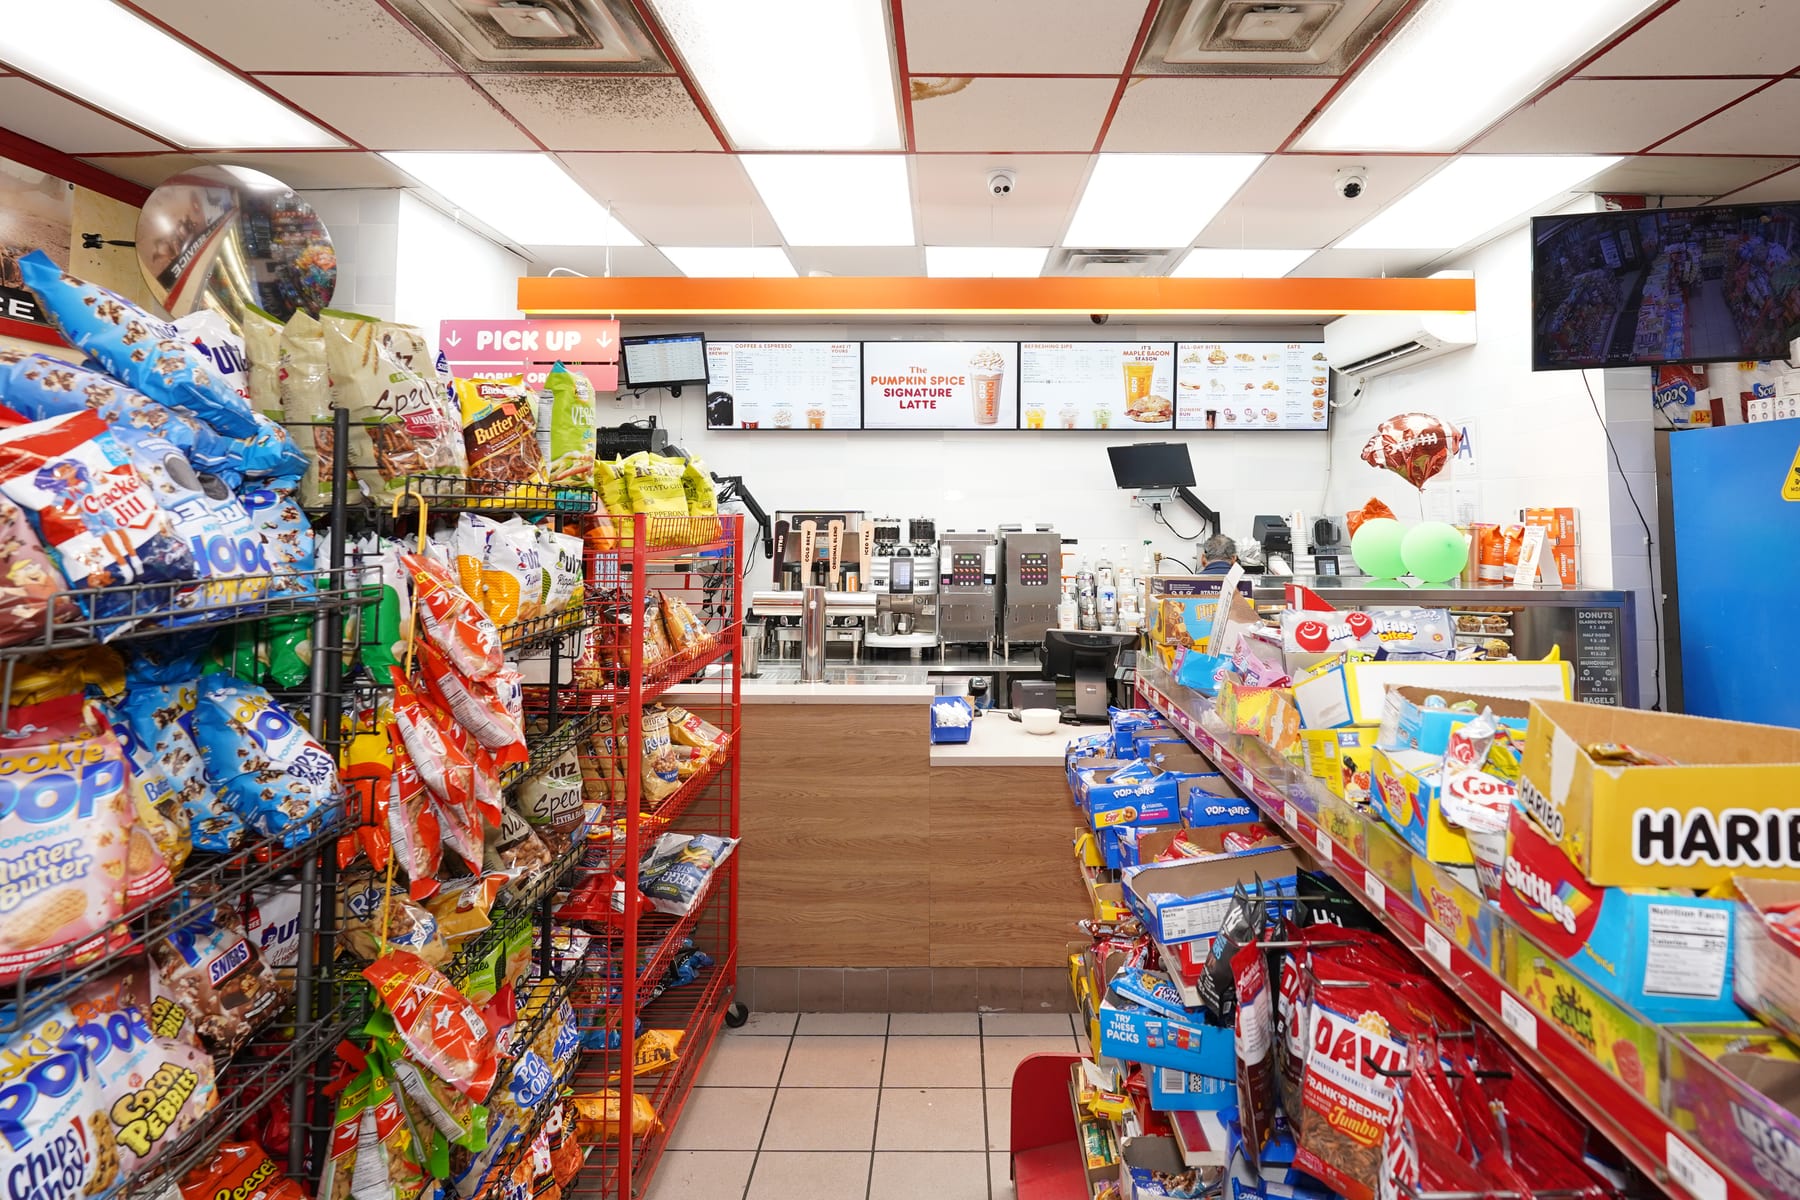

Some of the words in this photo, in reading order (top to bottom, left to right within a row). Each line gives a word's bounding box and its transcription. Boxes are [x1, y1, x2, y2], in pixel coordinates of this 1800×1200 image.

[476, 330, 539, 351] PICK
[545, 331, 581, 351] UP
[526, 371, 549, 384] OR
[909, 366, 928, 374] The
[870, 376, 927, 386] PUMPKIN
[929, 376, 966, 386] SPICE
[883, 388, 953, 398] SIGNATURE
[899, 400, 937, 409] LATTE
[473, 415, 514, 445] Butter
[84, 475, 143, 514] Cracke
[113, 495, 148, 528] Jill
[1578, 611, 1614, 619] DONUTS
[1372, 618, 1418, 635] HEADS
[1378, 632, 1414, 642] bites
[1583, 696, 1615, 704] BAGELS
[1521, 777, 1565, 841] HARIBO
[1504, 855, 1577, 935] Skittles
[1109, 1021, 1136, 1033] THESE
[1114, 1013, 1131, 1023] TRY
[1106, 1029, 1140, 1044] PACKS
[1314, 1015, 1401, 1090] DAVI
[517, 1063, 552, 1104] CORN
[109, 1061, 184, 1128] COCOA
[1306, 1073, 1348, 1107] FRANK'S
[1347, 1096, 1391, 1128] REDHO
[114, 1067, 199, 1158] PEBBLES
[1327, 1105, 1379, 1139] Jumbo
